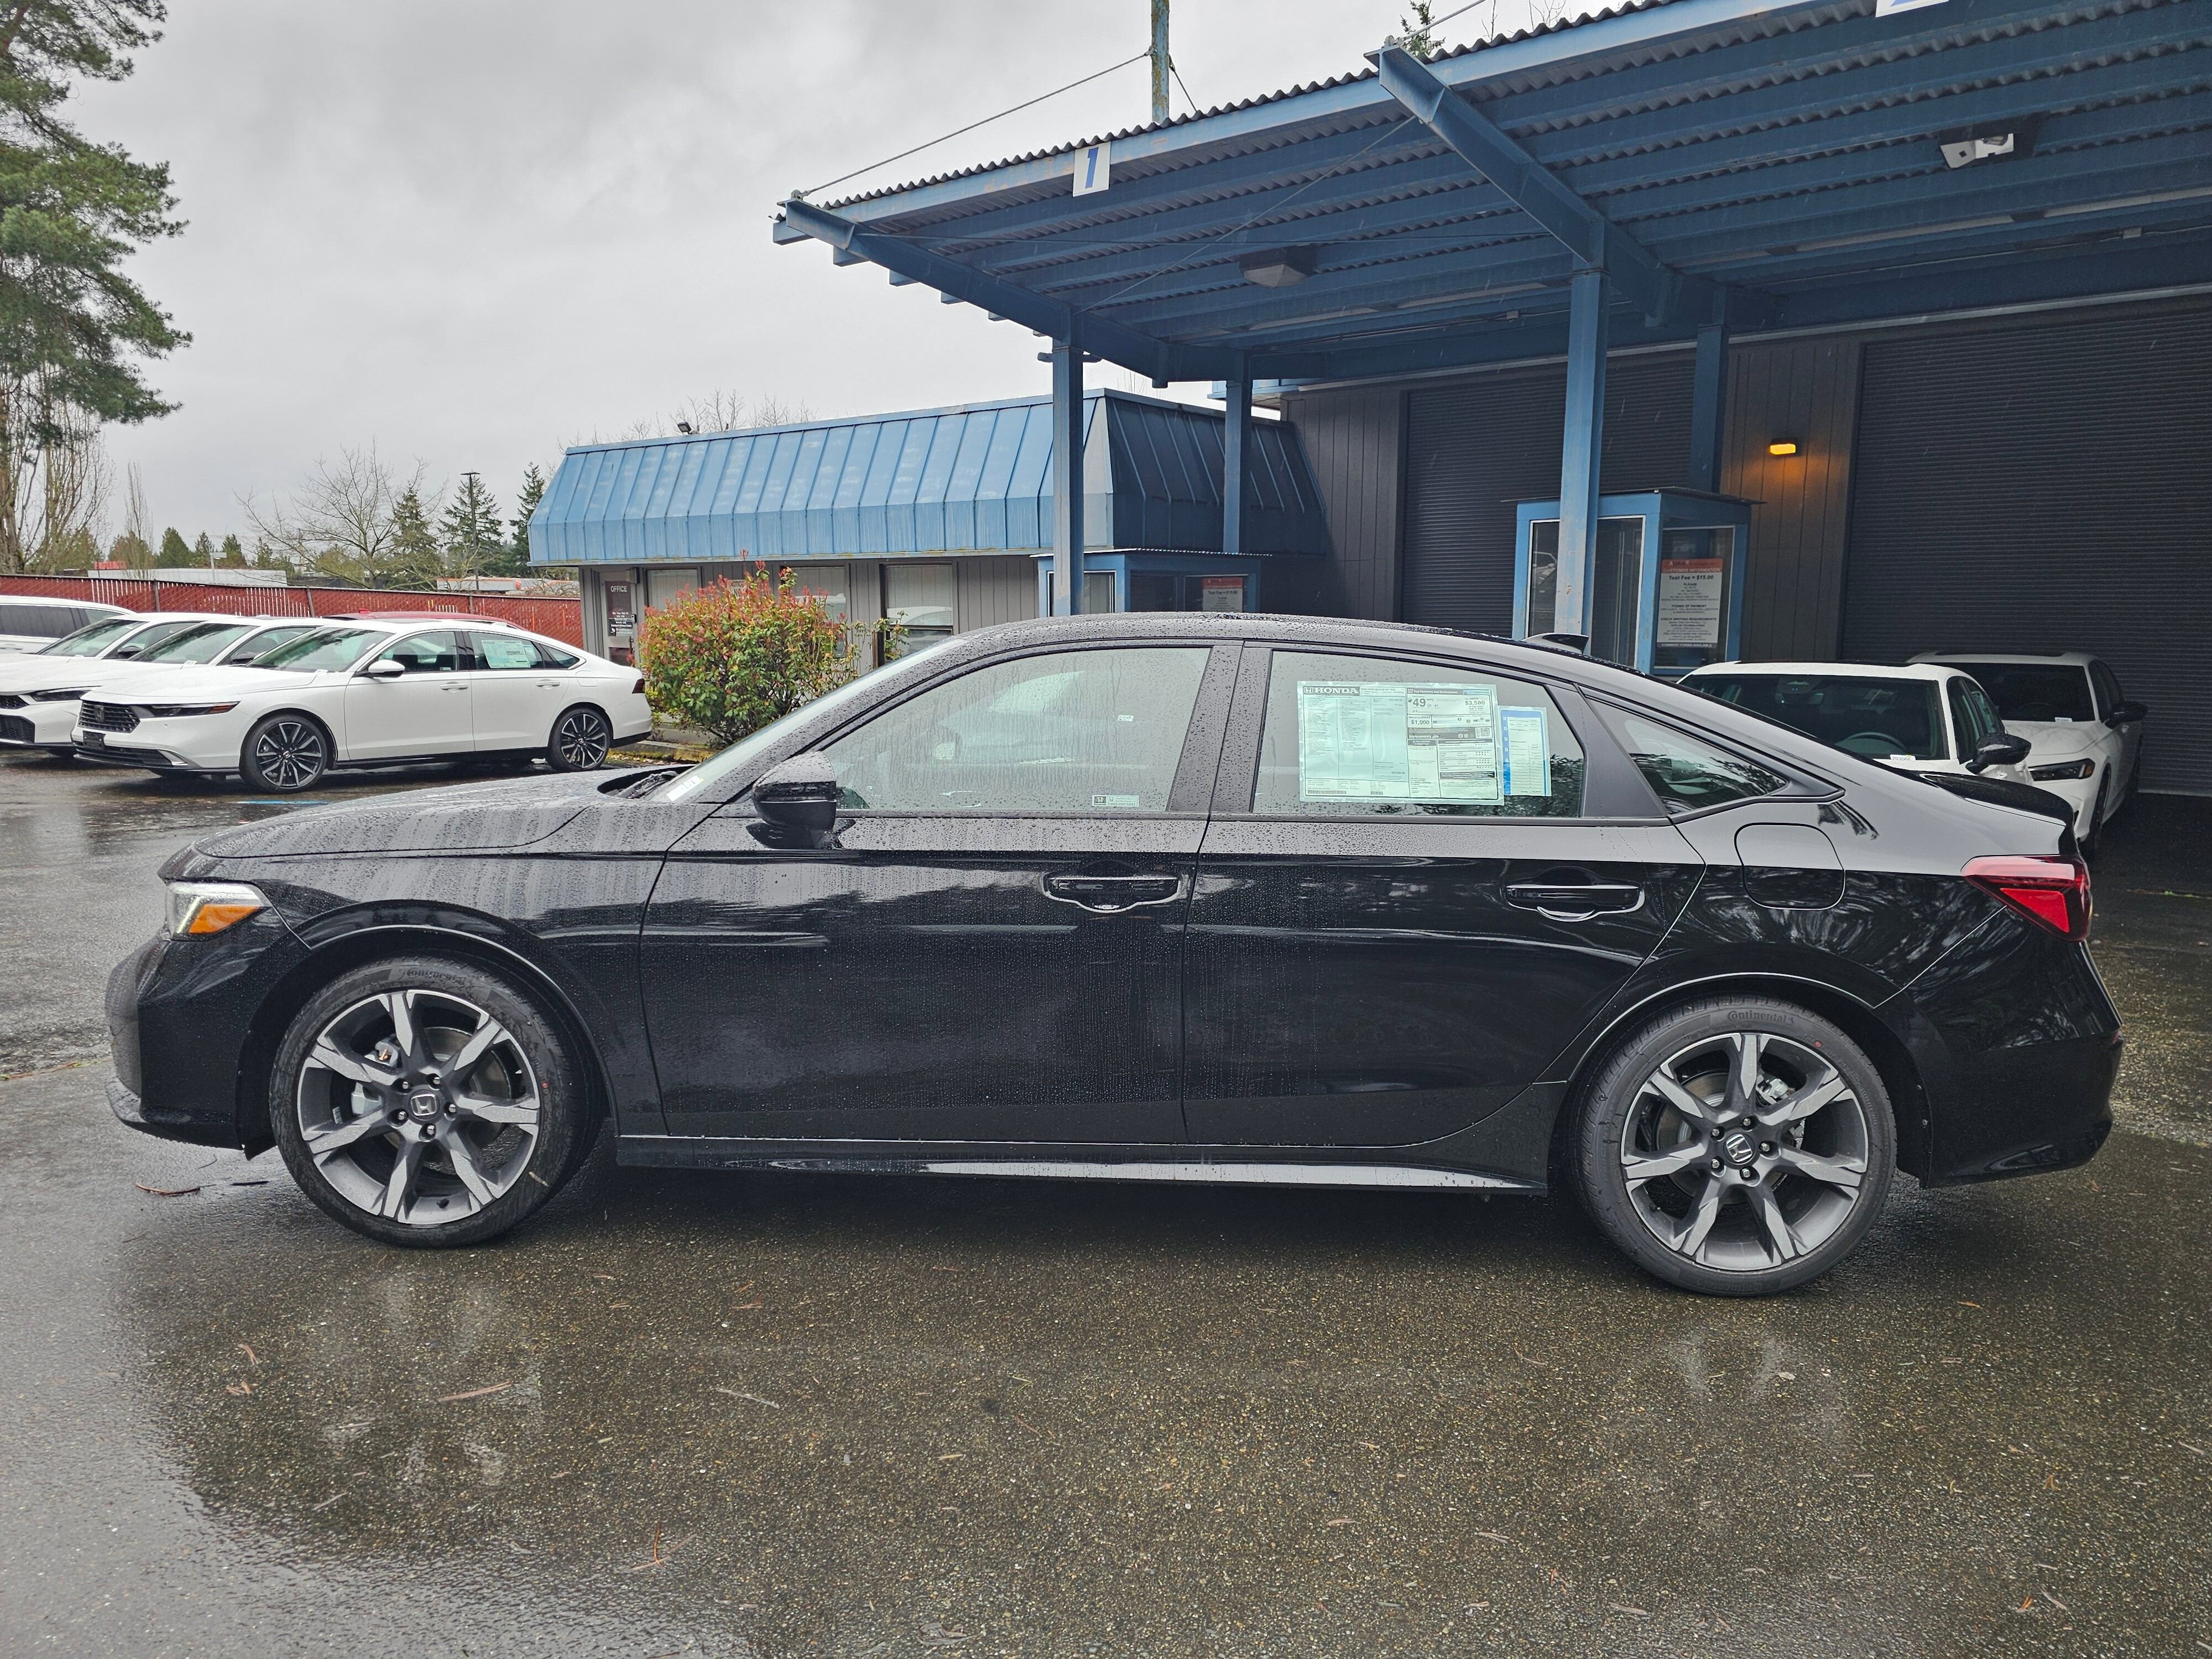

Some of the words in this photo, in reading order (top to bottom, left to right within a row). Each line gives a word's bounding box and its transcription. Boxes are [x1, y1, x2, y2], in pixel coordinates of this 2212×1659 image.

[1086, 147, 1099, 189] 1
[1413, 698, 1426, 707] 49
[1727, 1010, 1786, 1023] Continental
